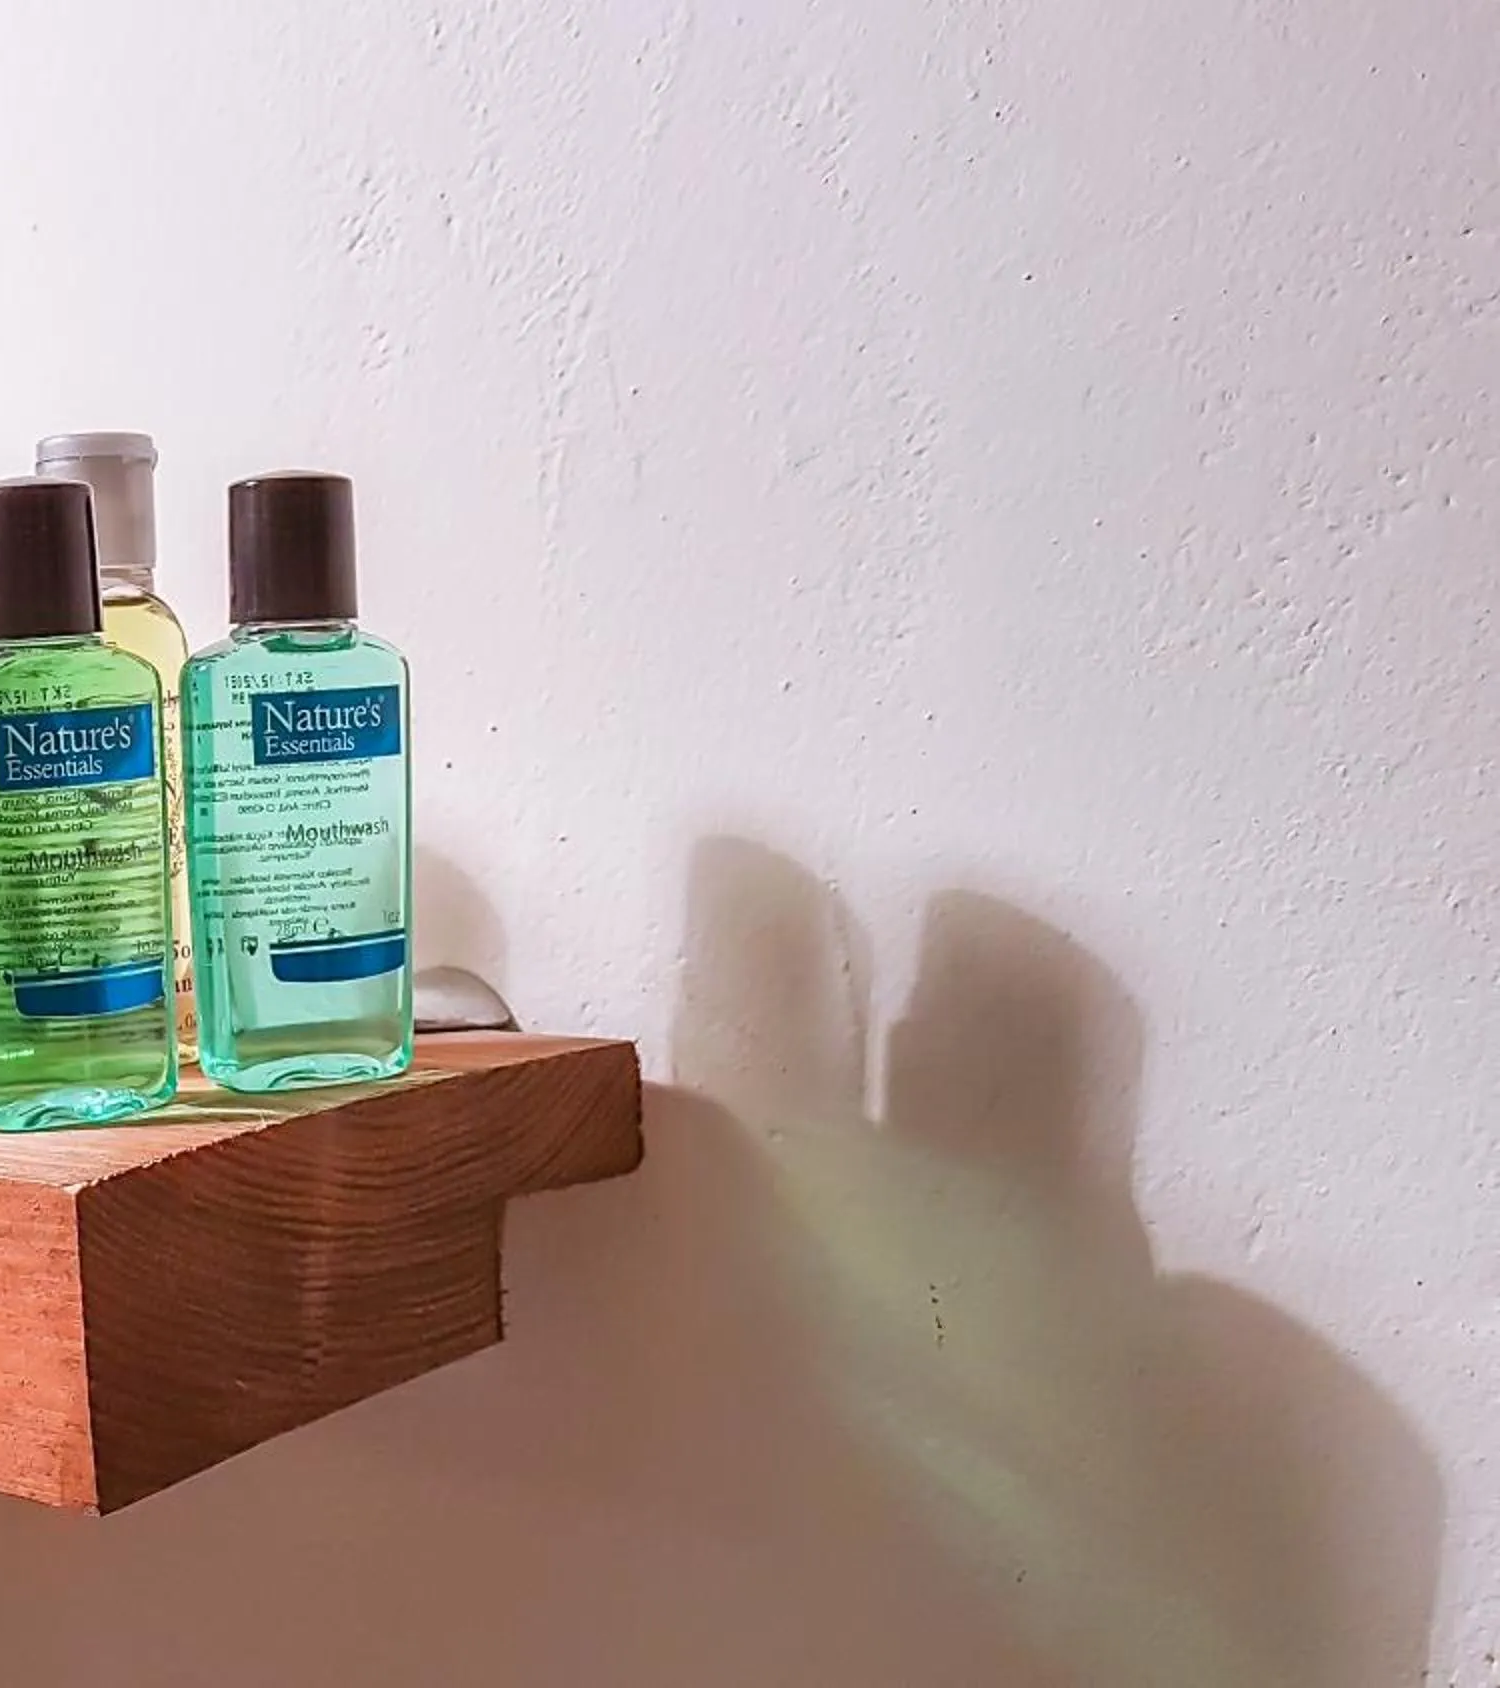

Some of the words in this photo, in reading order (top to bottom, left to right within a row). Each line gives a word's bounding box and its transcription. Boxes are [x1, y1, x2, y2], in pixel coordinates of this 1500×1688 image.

[261, 695, 382, 734] Nature's
[2, 717, 132, 760] Nature's
[264, 731, 356, 757] Essentials
[5, 753, 103, 781] Essentials
[285, 816, 389, 843] Mouthwash
